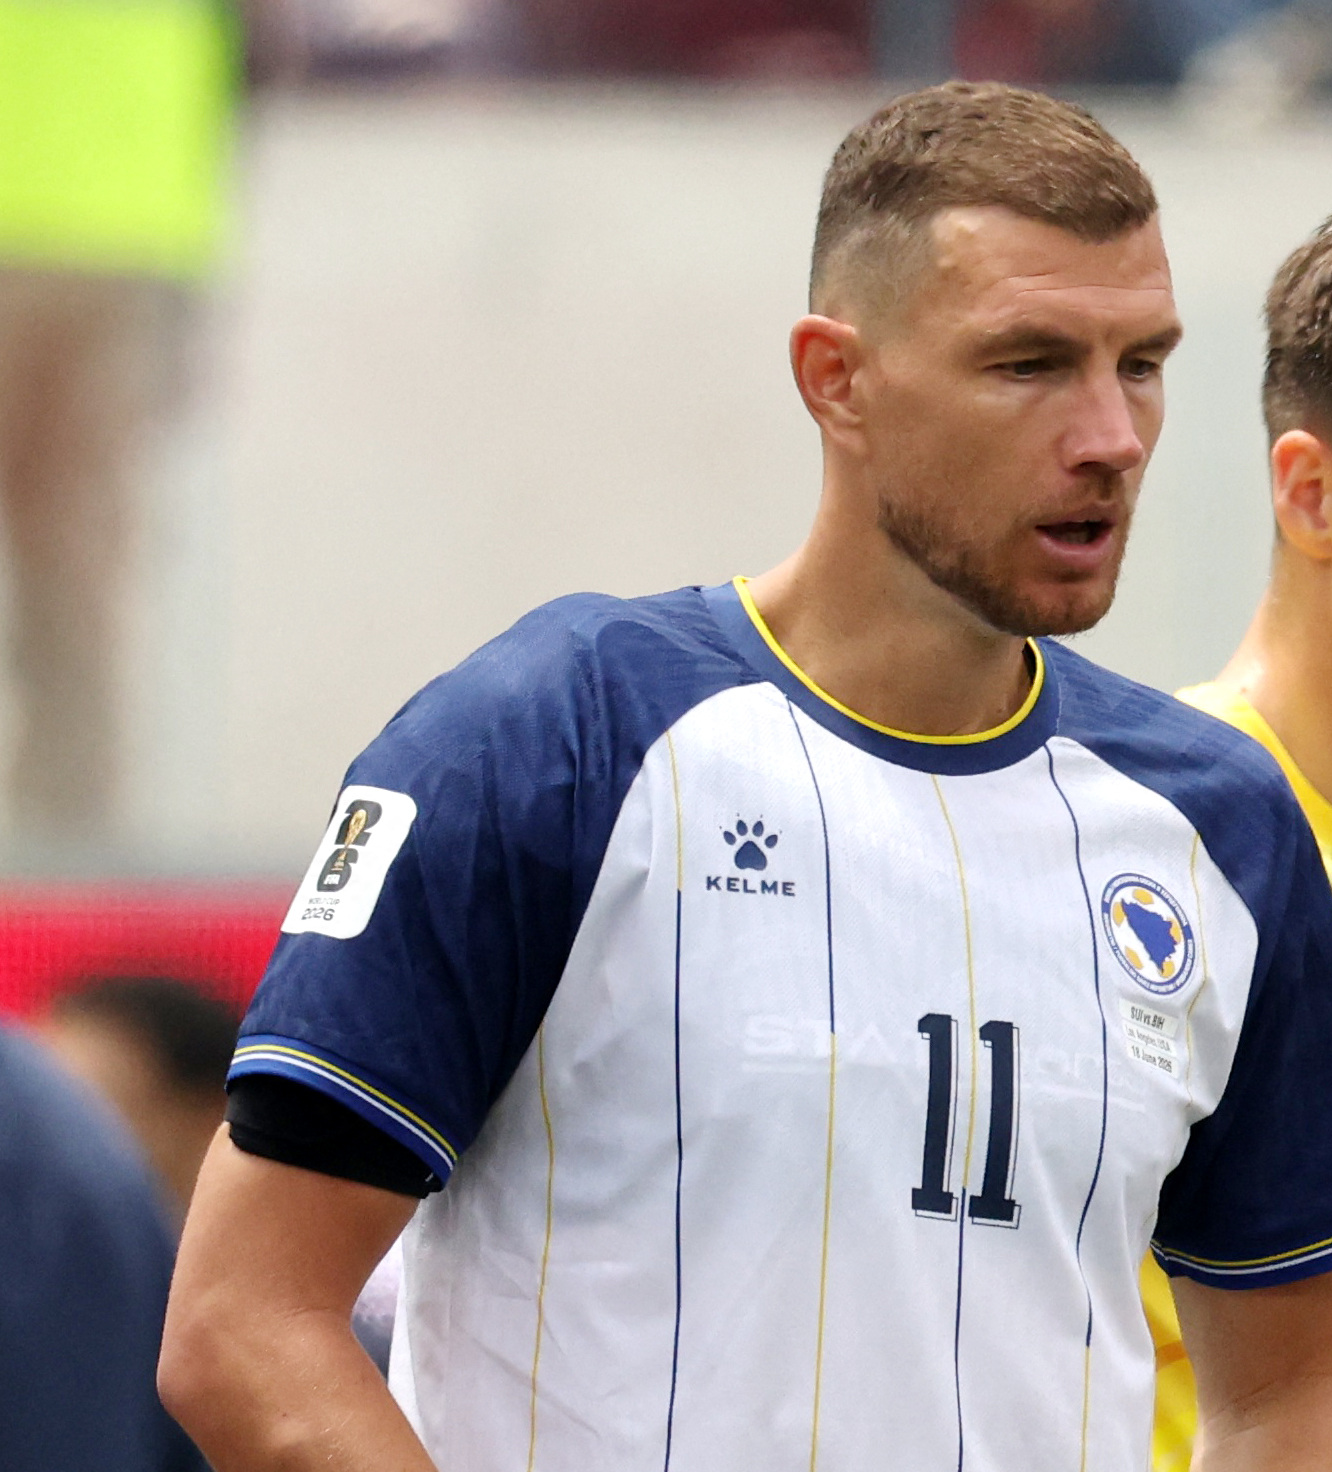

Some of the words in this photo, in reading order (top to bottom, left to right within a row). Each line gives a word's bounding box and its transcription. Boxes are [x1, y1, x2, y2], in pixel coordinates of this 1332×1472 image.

[706, 876, 796, 897] KELME
[1141, 1049, 1157, 1066] June
[912, 1013, 1022, 1230] 11
